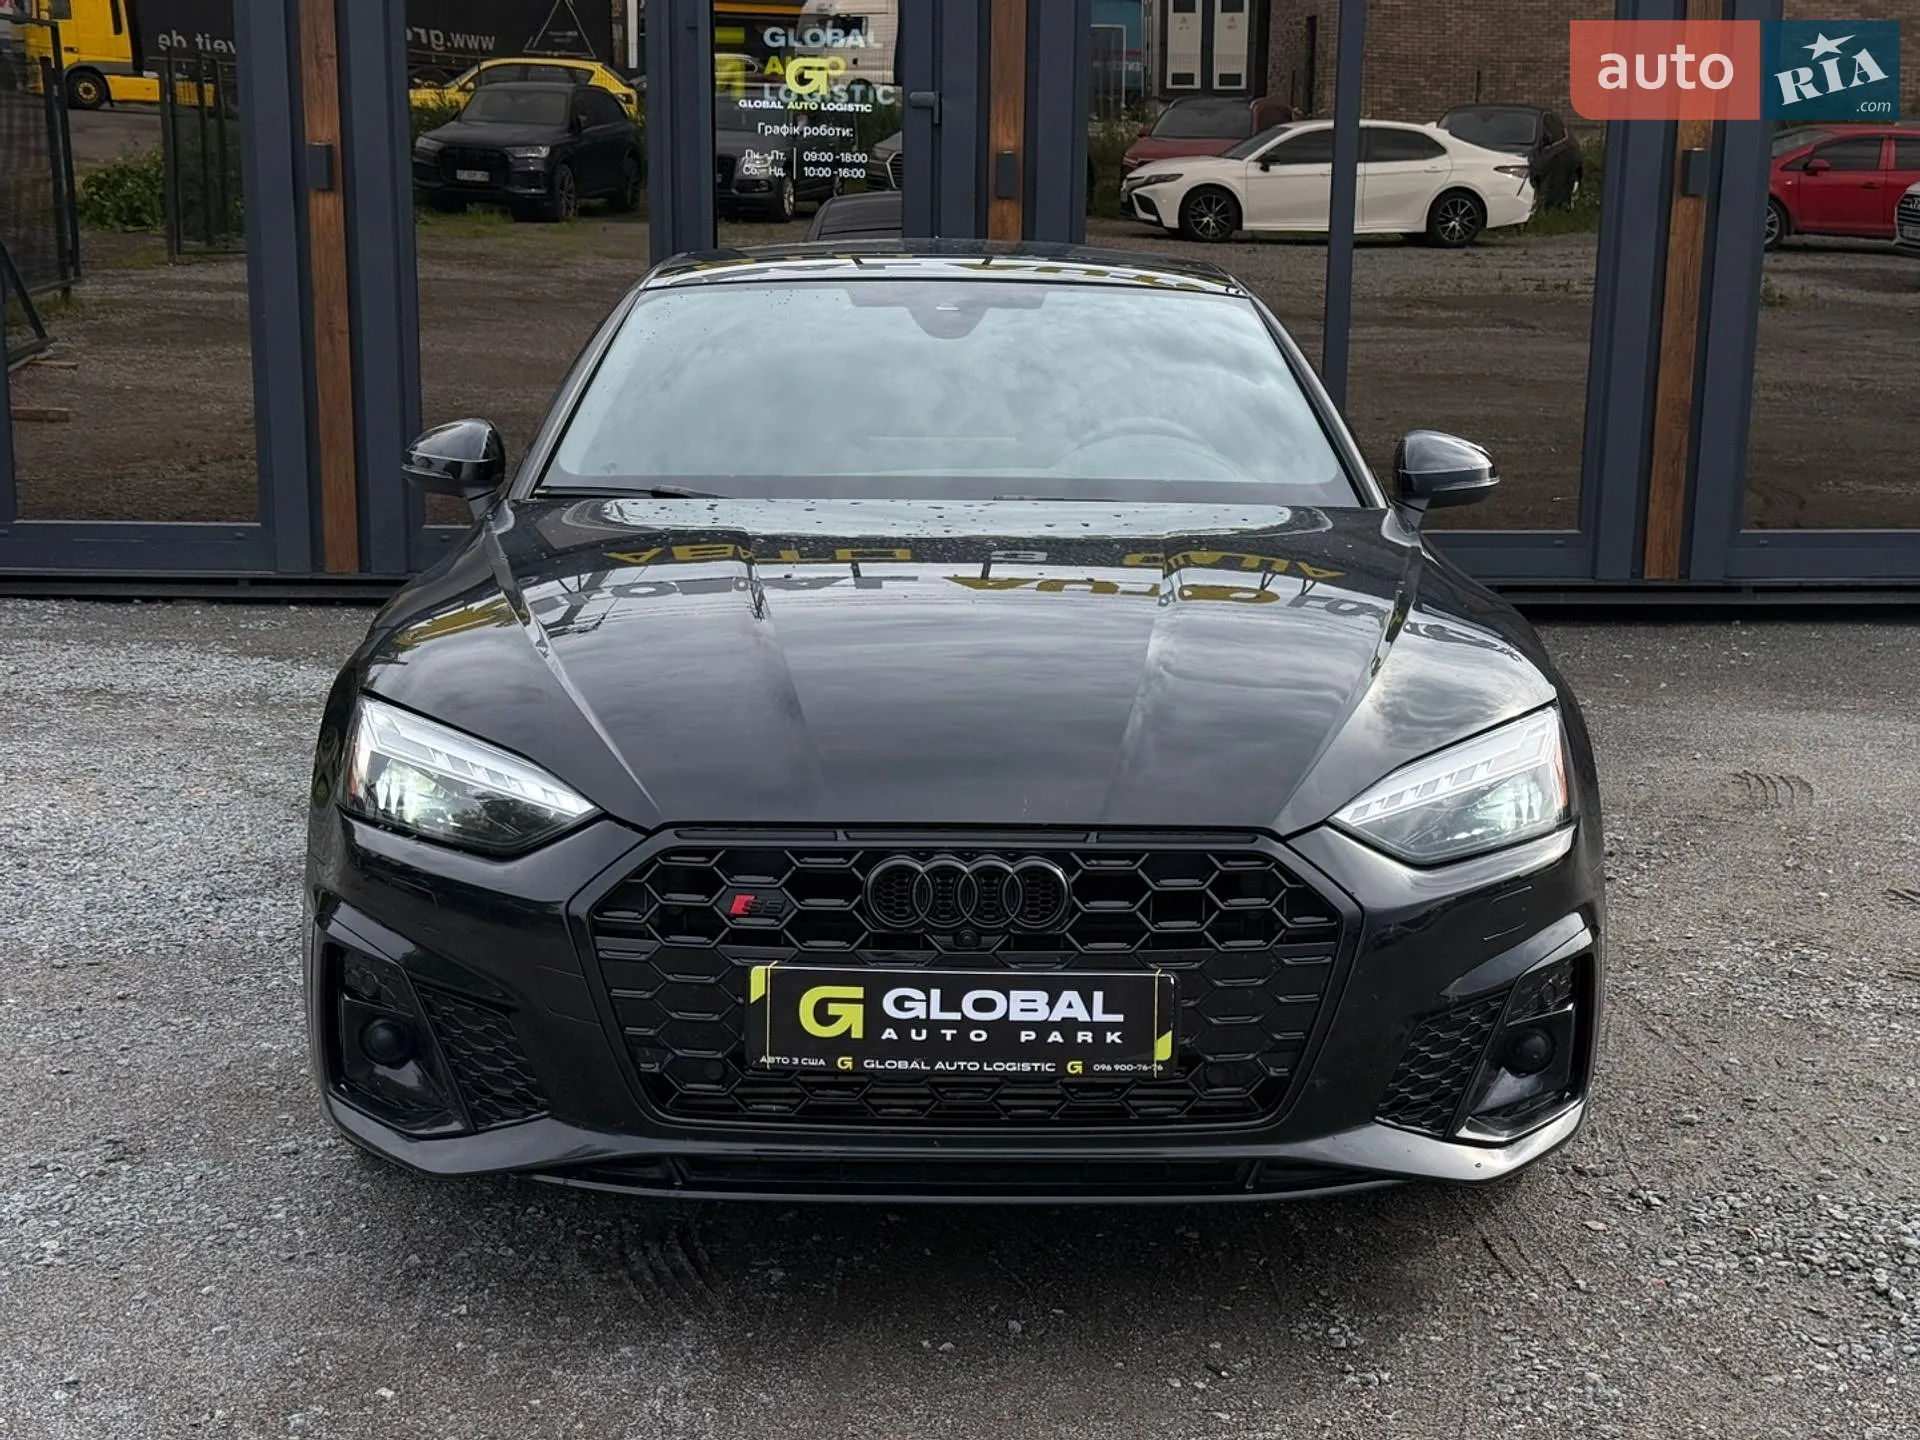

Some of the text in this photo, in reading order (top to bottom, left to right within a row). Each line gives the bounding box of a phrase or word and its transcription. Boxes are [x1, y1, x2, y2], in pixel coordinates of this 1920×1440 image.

[763, 26, 883, 48] GLOBAL
[738, 99, 873, 113] GLOBAL AUTO LOGISTIC
[757, 122, 854, 138] Графік роботи:
[803, 151, 834, 162] 09:00
[803, 167, 832, 178] 10:00
[882, 987, 1124, 1023] GLOBAL
[880, 1027, 1123, 1044] AUTO PARK
[801, 1057, 827, 1066] США
[863, 1058, 1056, 1073] GLOBAL AUTO LOGISTIC
